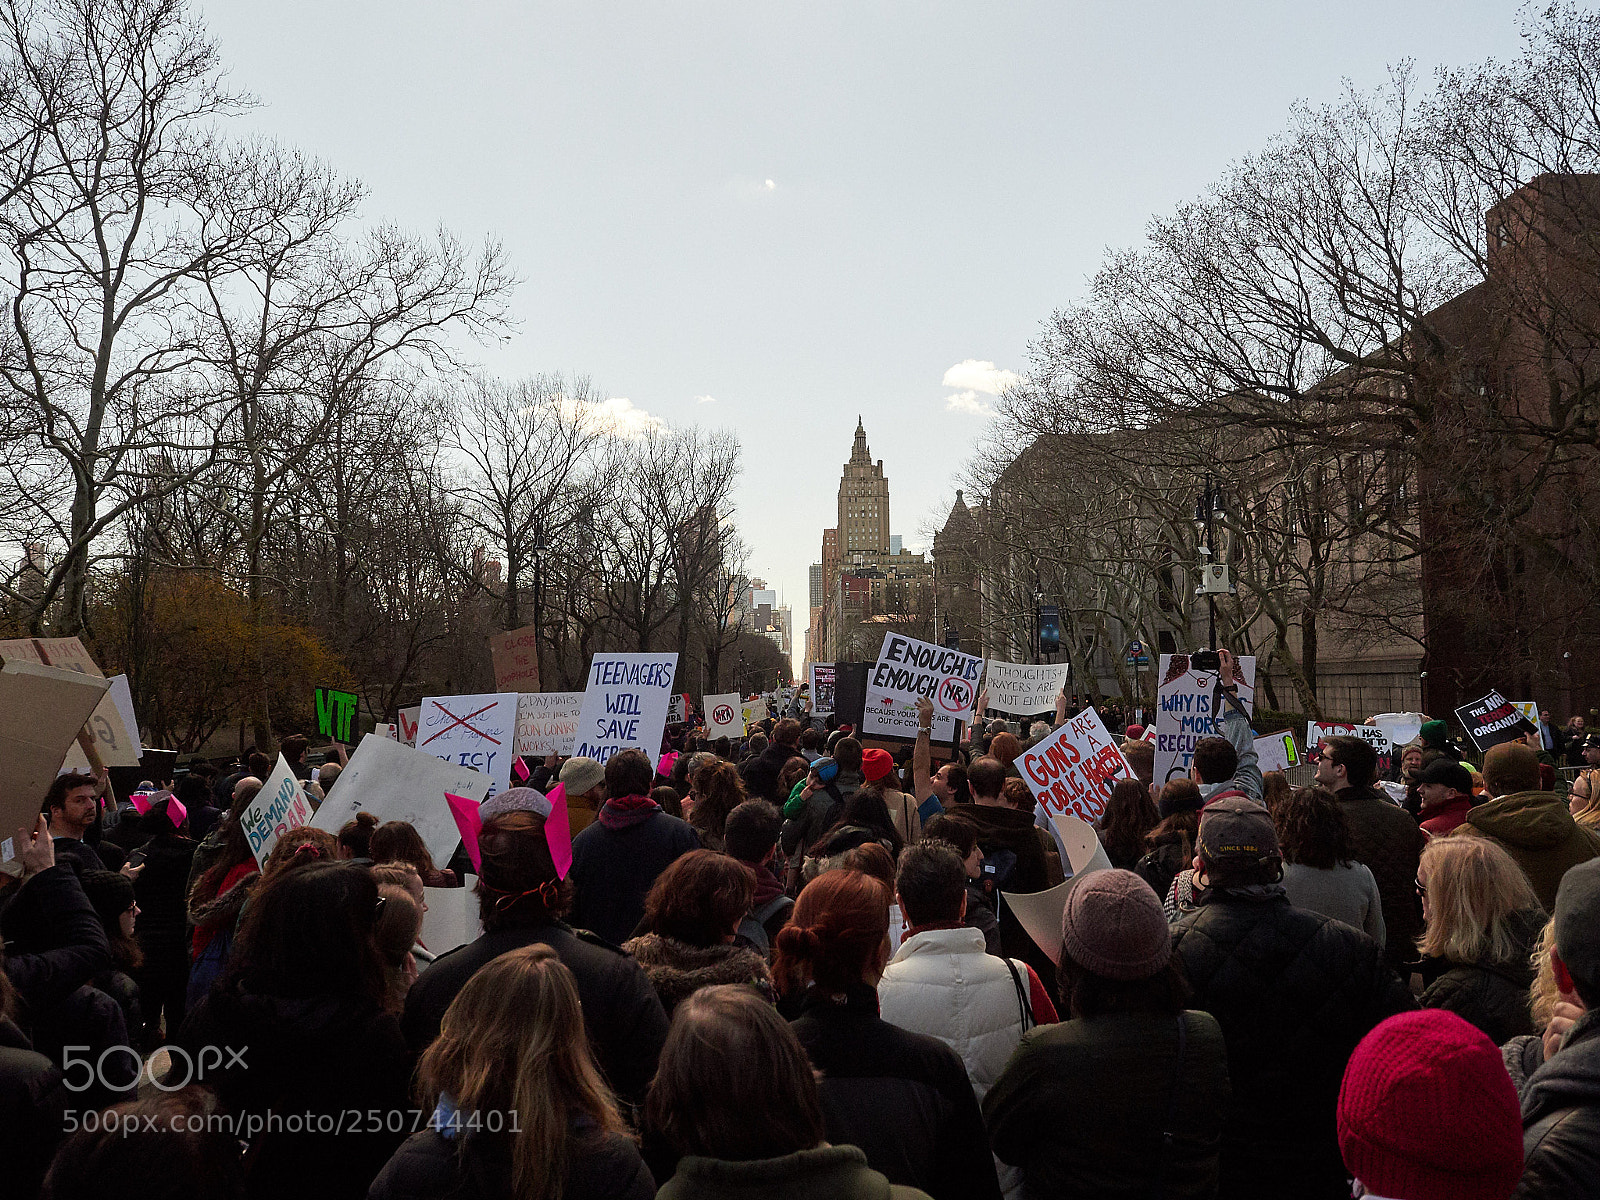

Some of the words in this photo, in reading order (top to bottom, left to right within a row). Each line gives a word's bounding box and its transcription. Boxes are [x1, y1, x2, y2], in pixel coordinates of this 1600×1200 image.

[884, 637, 966, 677] ENOUGH
[963, 659, 983, 681] IS
[593, 661, 673, 689] TEENAGERS
[872, 662, 940, 699] ENOUGH
[987, 677, 1031, 693] PRAYERS
[1036, 681, 1057, 693] ARE
[605, 693, 642, 716] WILL
[943, 683, 970, 705] NRA
[998, 693, 1020, 706] NOT
[1161, 694, 1194, 712] WHY
[1197, 694, 1210, 713] IS
[315, 688, 358, 743] WTF
[570, 709, 581, 717] TO
[714, 709, 733, 722] NRA
[866, 706, 896, 717] BECAUSE
[897, 710, 916, 719] YOUR
[937, 715, 950, 723] ARE
[1468, 706, 1486, 718] THE
[518, 722, 541, 737] GUN
[543, 721, 579, 737] CONTRO
[595, 719, 640, 741] SAVE
[877, 717, 892, 725] OUT
[893, 719, 904, 727] OF
[904, 721, 936, 730] CONL
[1070, 712, 1096, 740] ARE
[1362, 728, 1382, 738] HAS
[1473, 710, 1524, 737] ORGANIZA
[1088, 734, 1102, 752] A
[1376, 738, 1388, 746] TO
[577, 742, 648, 767] AMER
[1024, 733, 1081, 787] GUNS
[1037, 770, 1085, 818] PUBLIC
[248, 777, 295, 853] DEMAND
